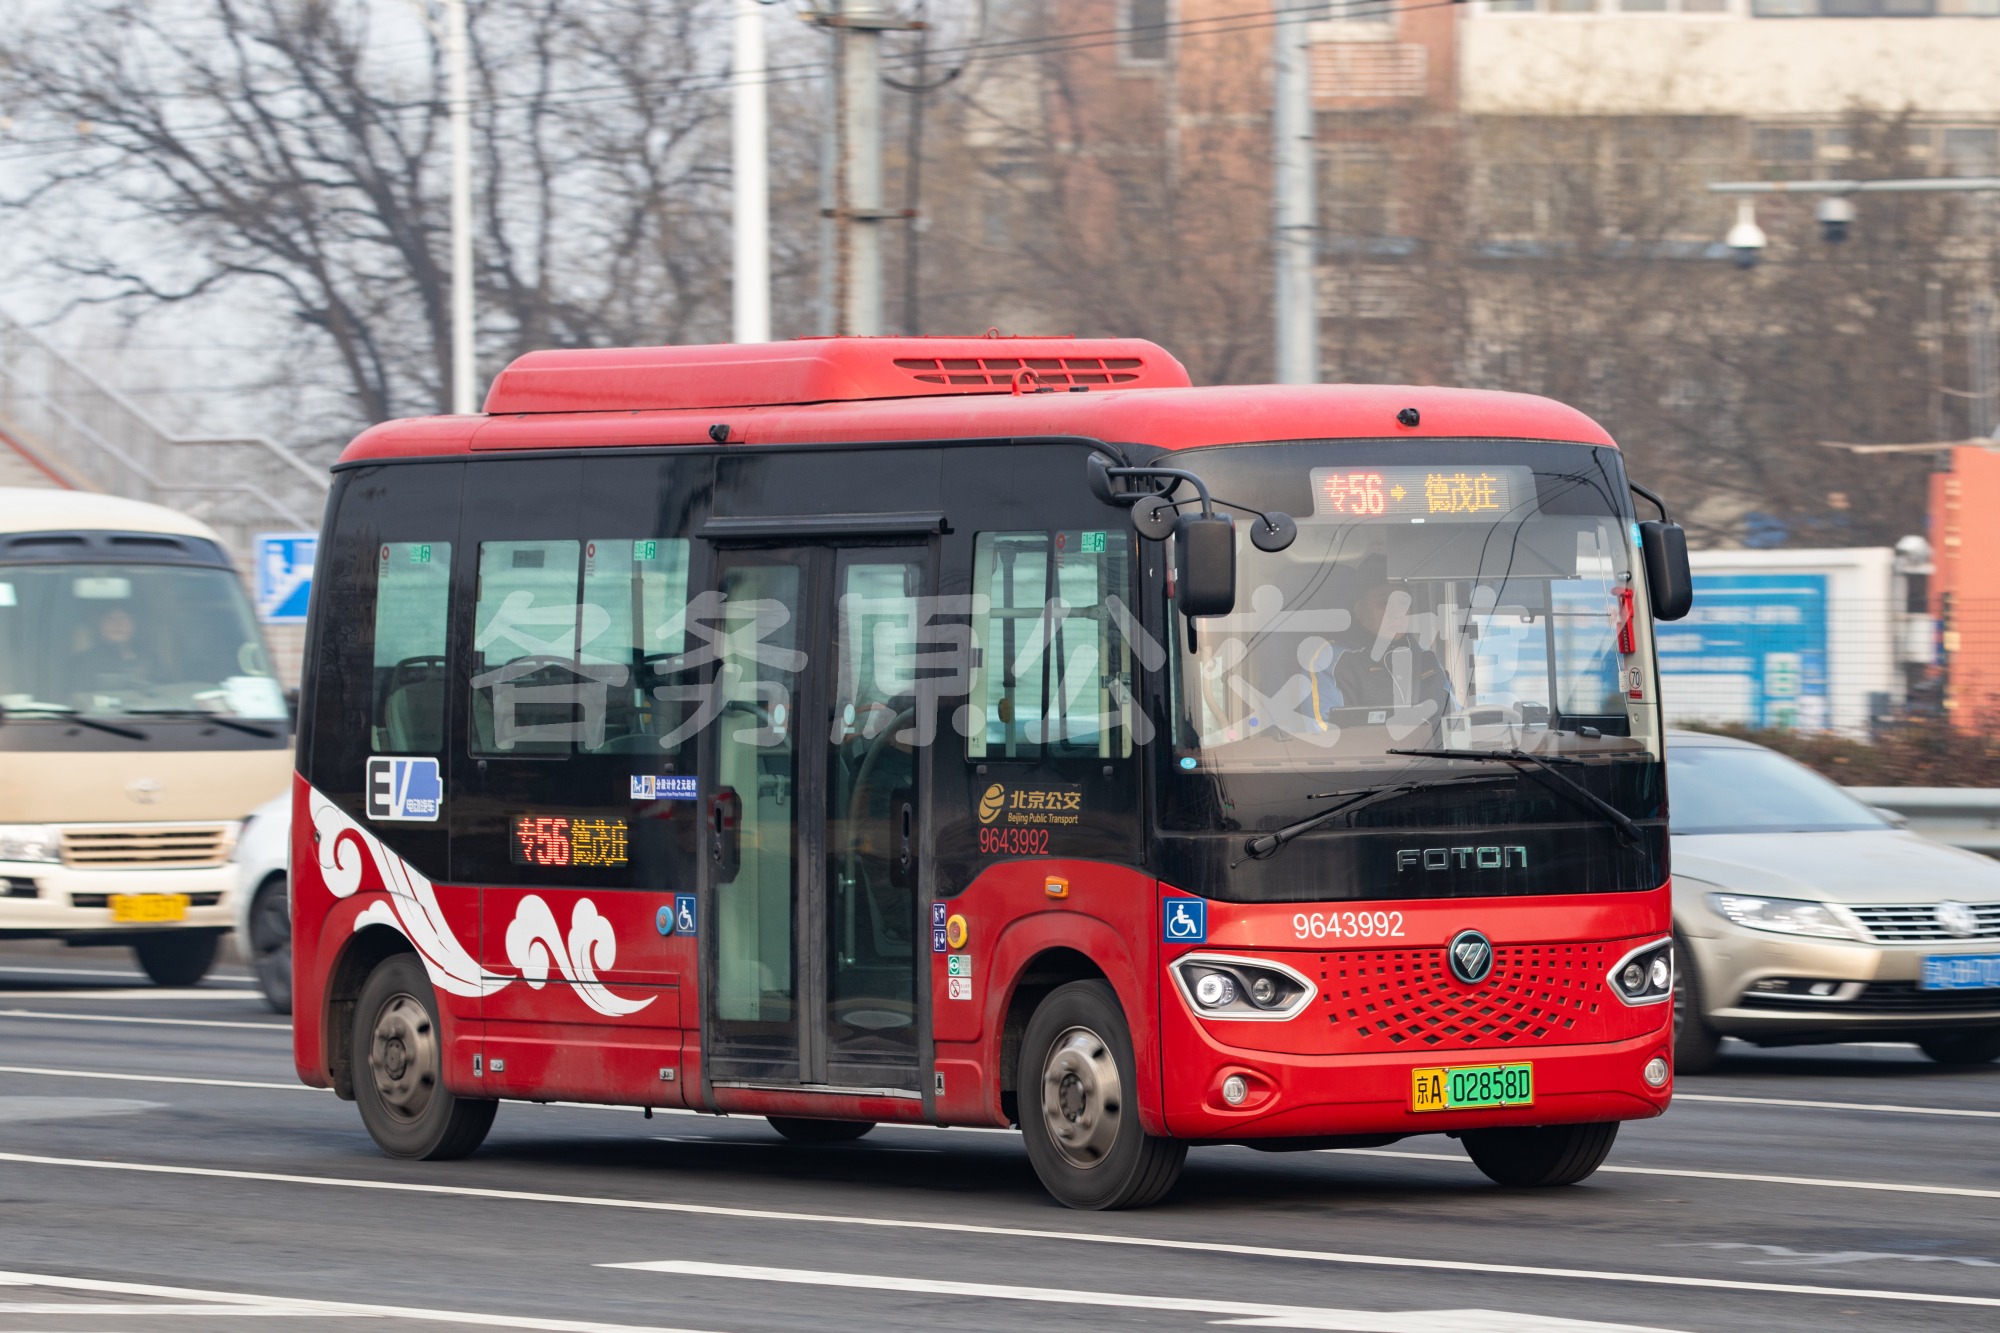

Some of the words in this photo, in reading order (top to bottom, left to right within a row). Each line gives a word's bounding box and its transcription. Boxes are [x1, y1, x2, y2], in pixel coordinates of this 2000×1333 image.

[1324, 472, 1385, 514] 专56
[1424, 473, 1499, 513] 德茂庄
[1631, 671, 1640, 686] 70
[369, 758, 414, 817] EV
[1009, 790, 1082, 810] 北京公交
[1008, 812, 1028, 825] Beijing
[1029, 813, 1048, 823] Public
[1048, 813, 1079, 826] Transport
[517, 818, 569, 865] 专56
[571, 819, 628, 866] 德茂庄
[980, 827, 1049, 855] 9643992
[1397, 846, 1527, 872] FOTON
[1292, 911, 1406, 940] 9643992
